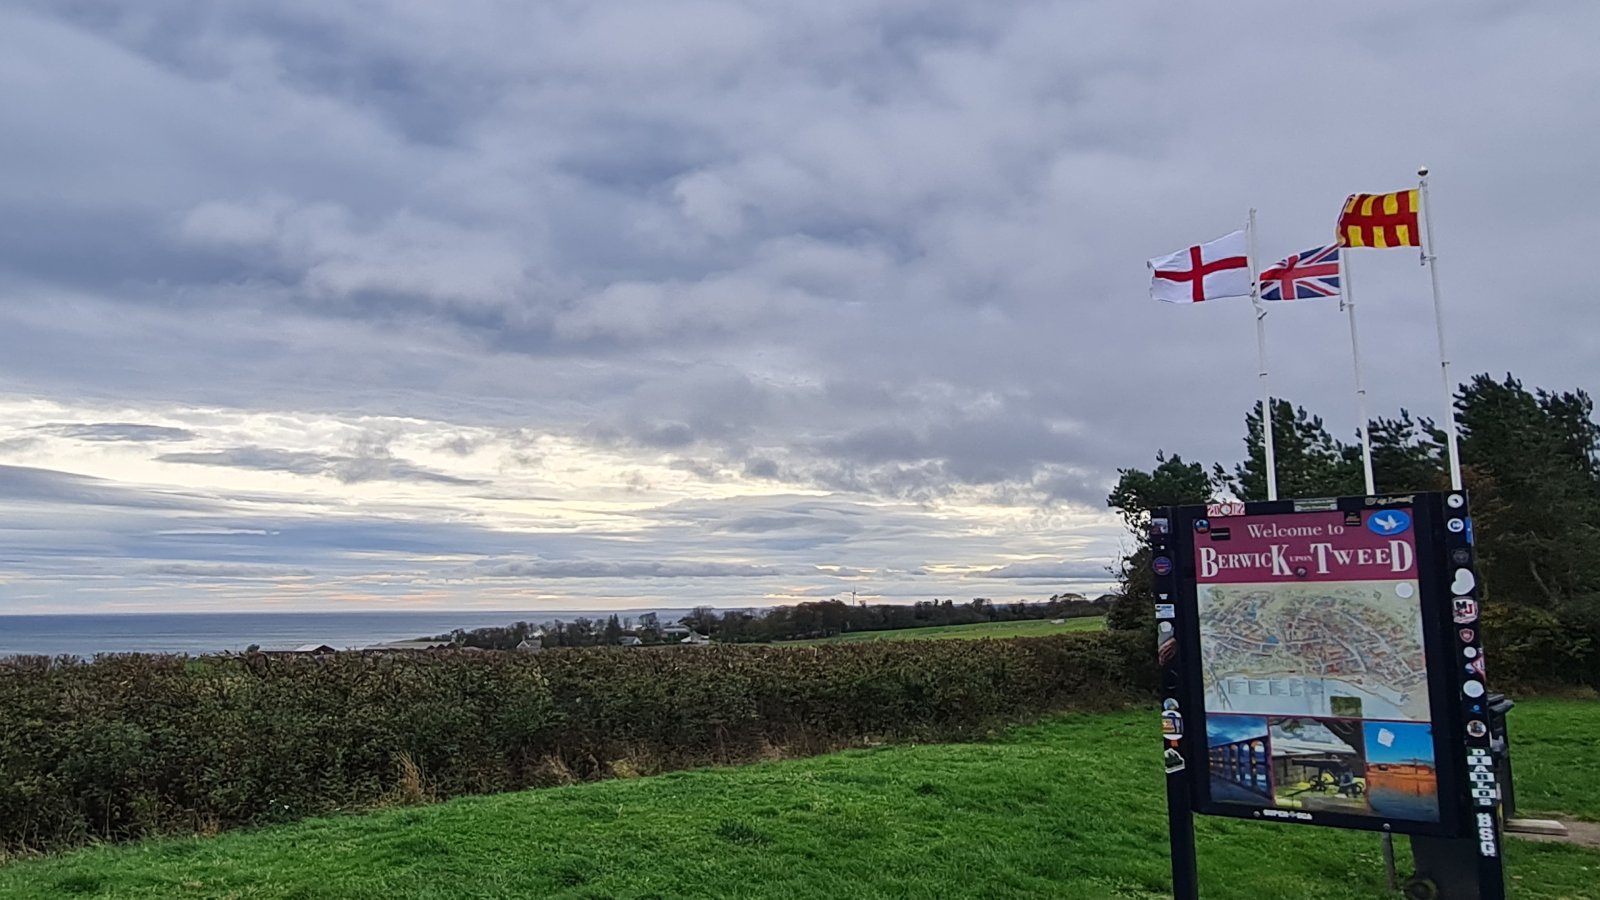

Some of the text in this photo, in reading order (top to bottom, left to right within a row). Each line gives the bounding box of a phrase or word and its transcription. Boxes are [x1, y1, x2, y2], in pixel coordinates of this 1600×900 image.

[1247, 521, 1344, 539] Welcome to
[1200, 545, 1294, 578] BERWICK
[1310, 539, 1413, 574] TWEED
[1476, 812, 1496, 857] BSG
